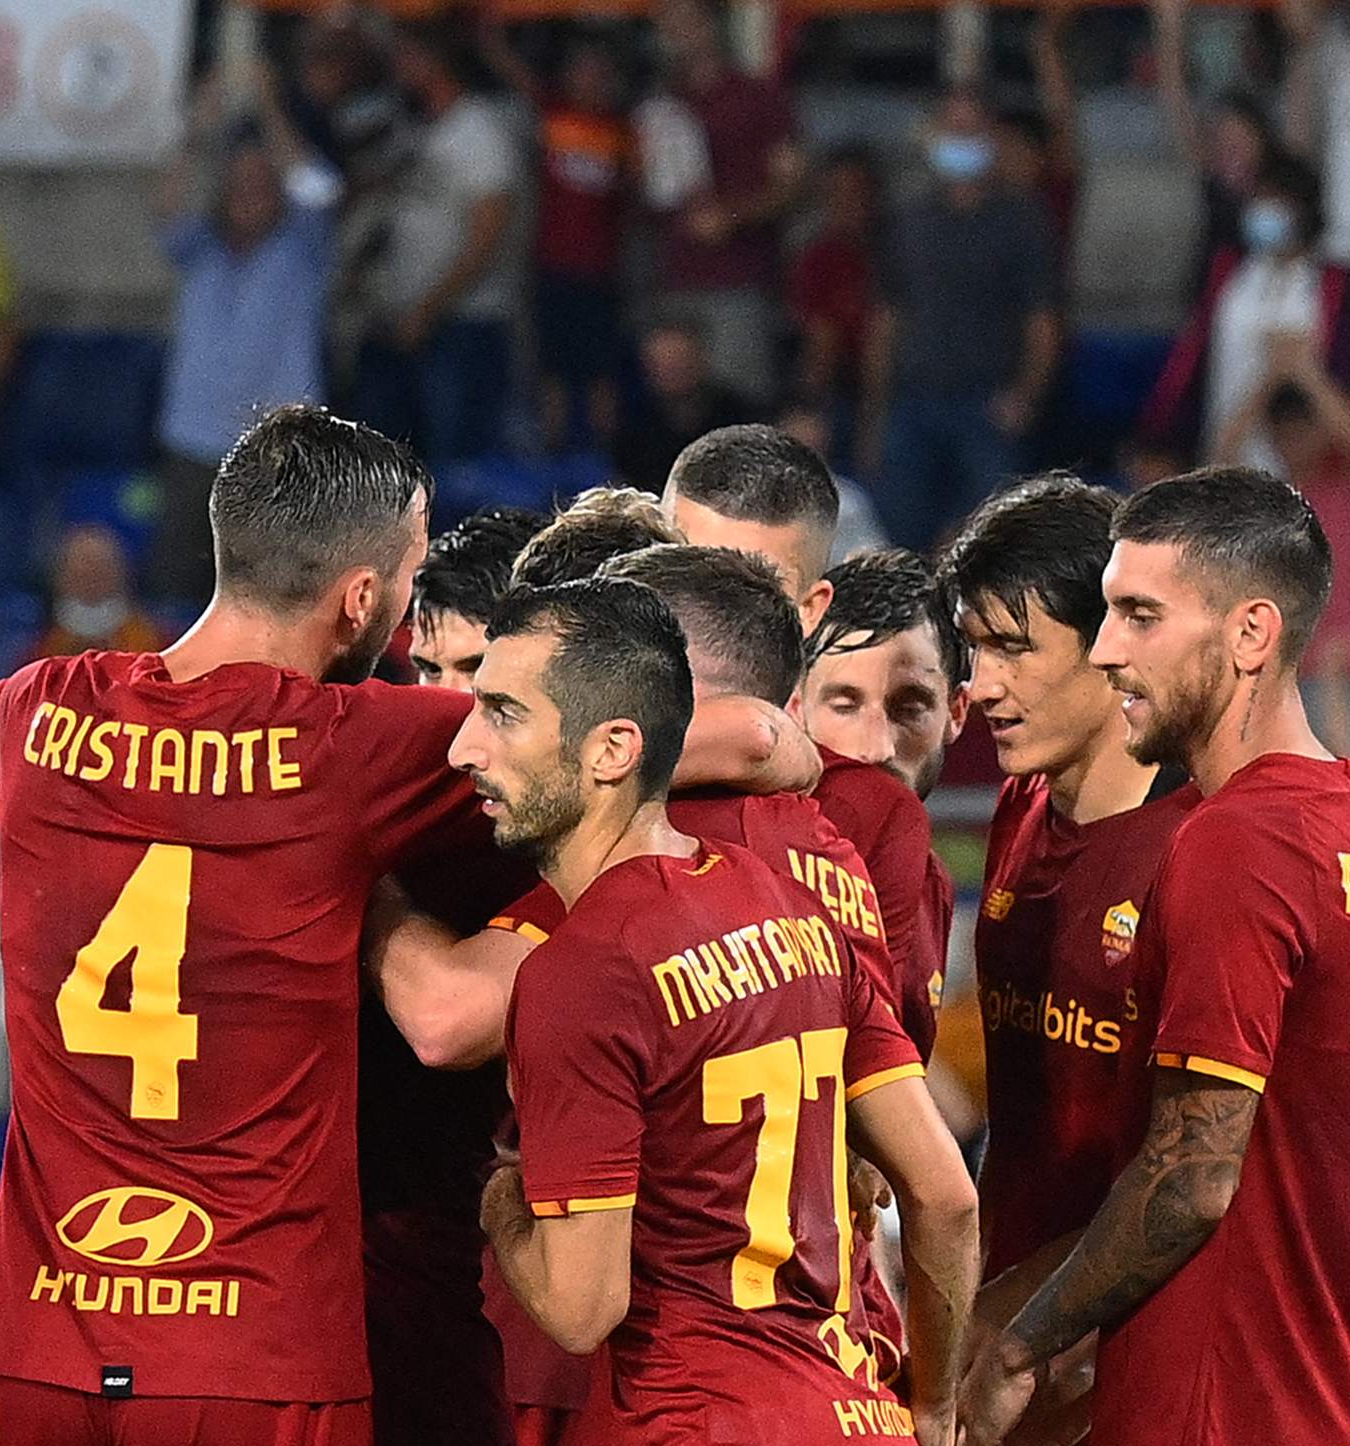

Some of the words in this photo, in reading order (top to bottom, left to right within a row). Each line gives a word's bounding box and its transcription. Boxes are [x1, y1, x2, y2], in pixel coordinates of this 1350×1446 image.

[24, 702, 302, 796] CRISTANTE
[56, 842, 198, 1120] 4
[787, 848, 882, 938] VERE
[703, 1027, 848, 1312] 77
